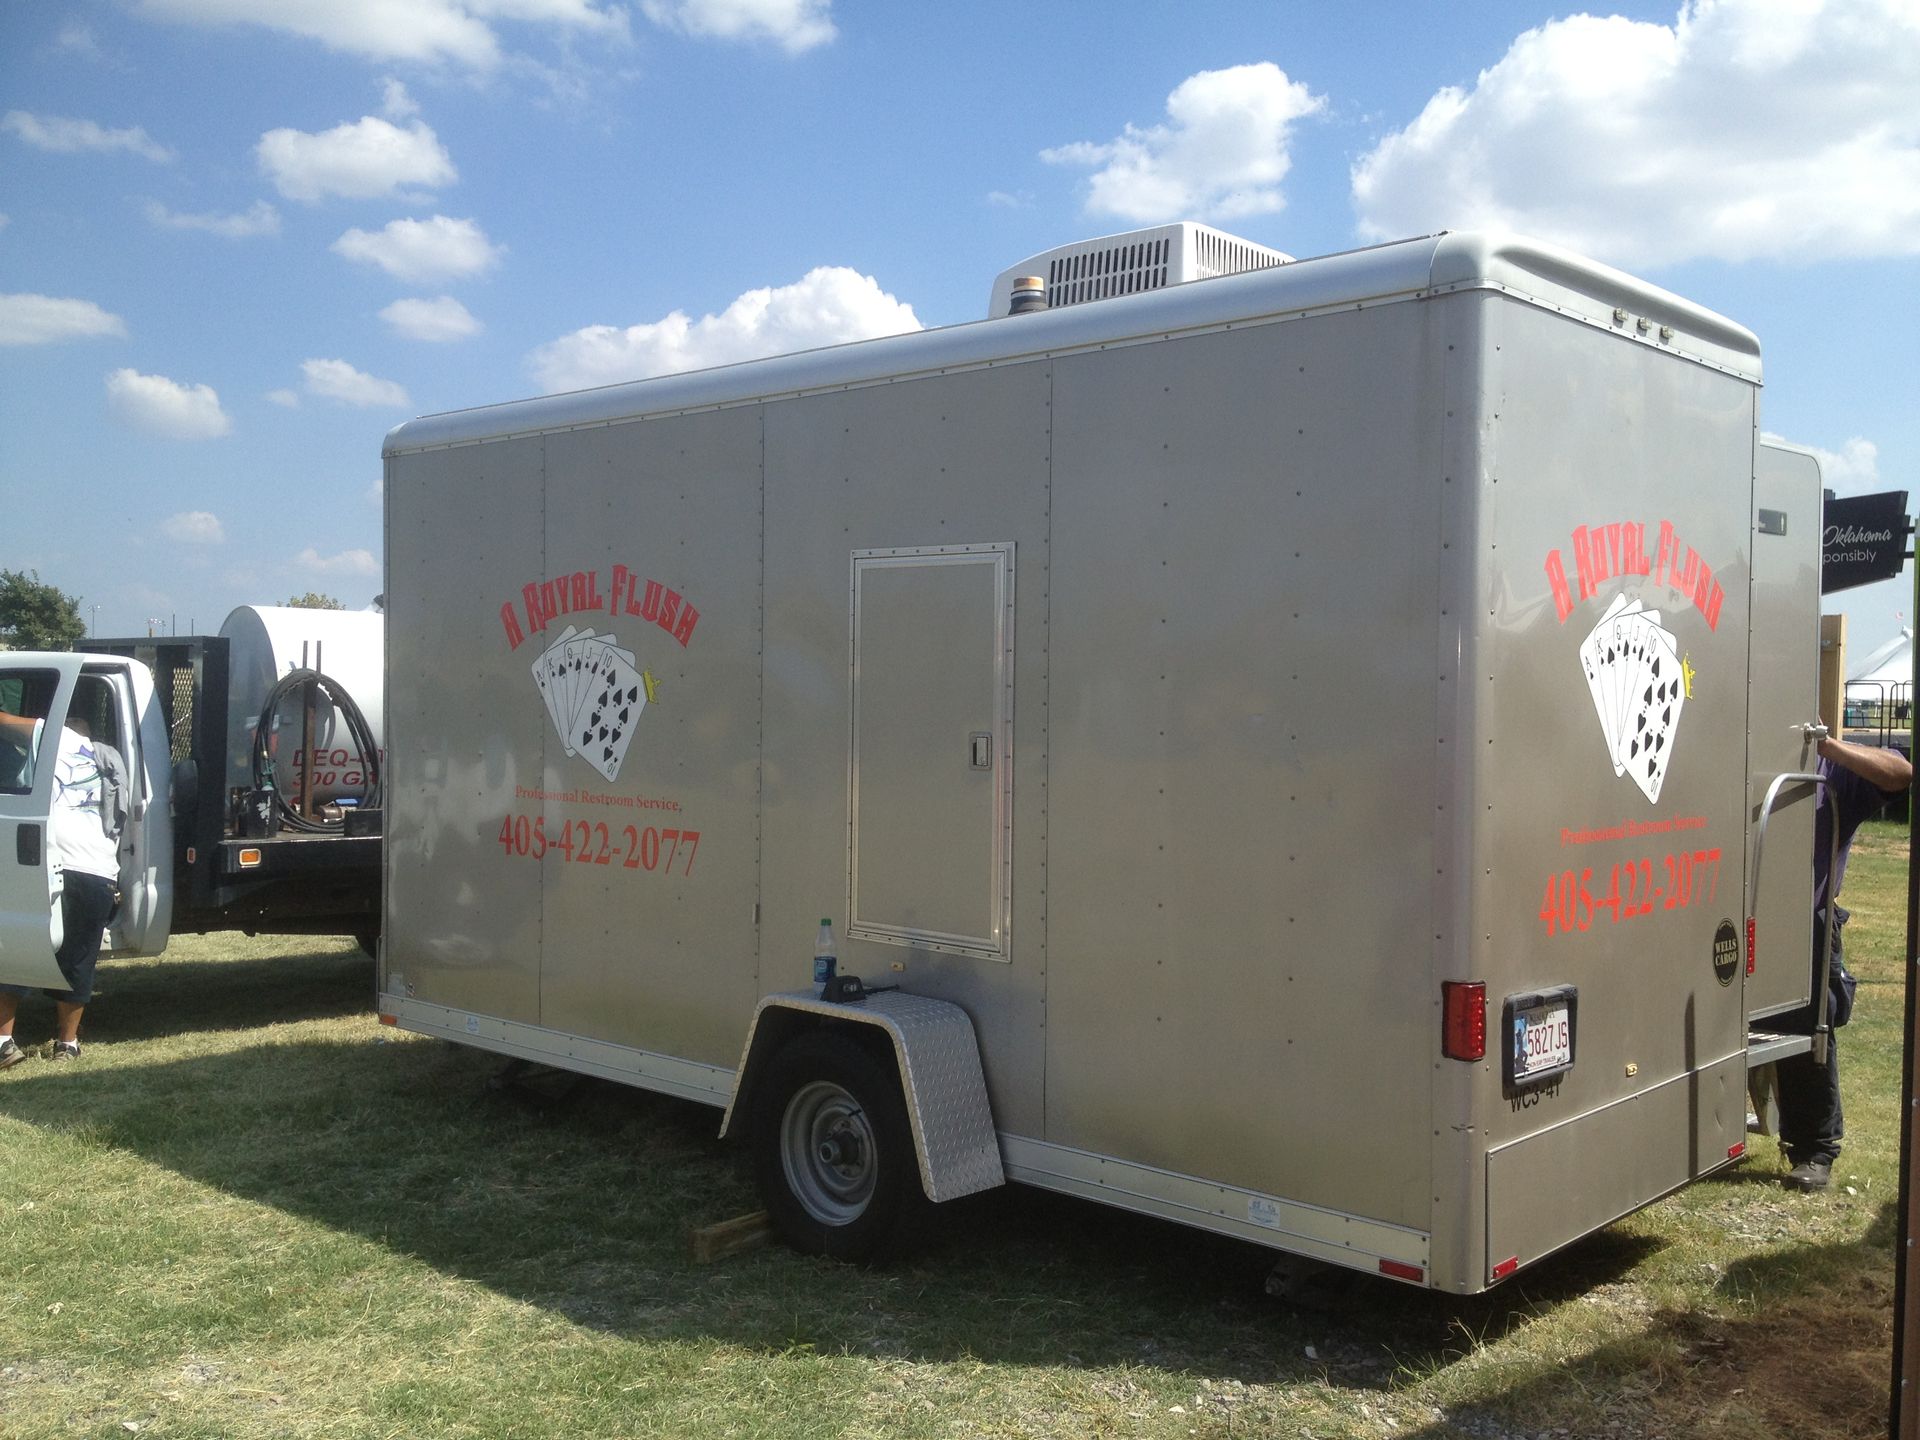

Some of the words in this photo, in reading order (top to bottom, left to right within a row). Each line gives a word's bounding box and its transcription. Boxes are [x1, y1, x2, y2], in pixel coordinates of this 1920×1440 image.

[1822, 525, 1891, 547] Oklahoma
[1822, 550, 1876, 564] ponsibly
[1544, 548, 1575, 625] A
[1572, 520, 1651, 602] ROYAL
[1655, 519, 1725, 632] FLUSH
[501, 601, 525, 651] A
[521, 570, 604, 634] ROYAL
[610, 564, 701, 649] FLUSH
[499, 814, 701, 877] 405-422-2077
[1538, 847, 1722, 938] 405-422-2077
[1715, 938, 1737, 954] WELLS
[1715, 951, 1737, 967] CARGO
